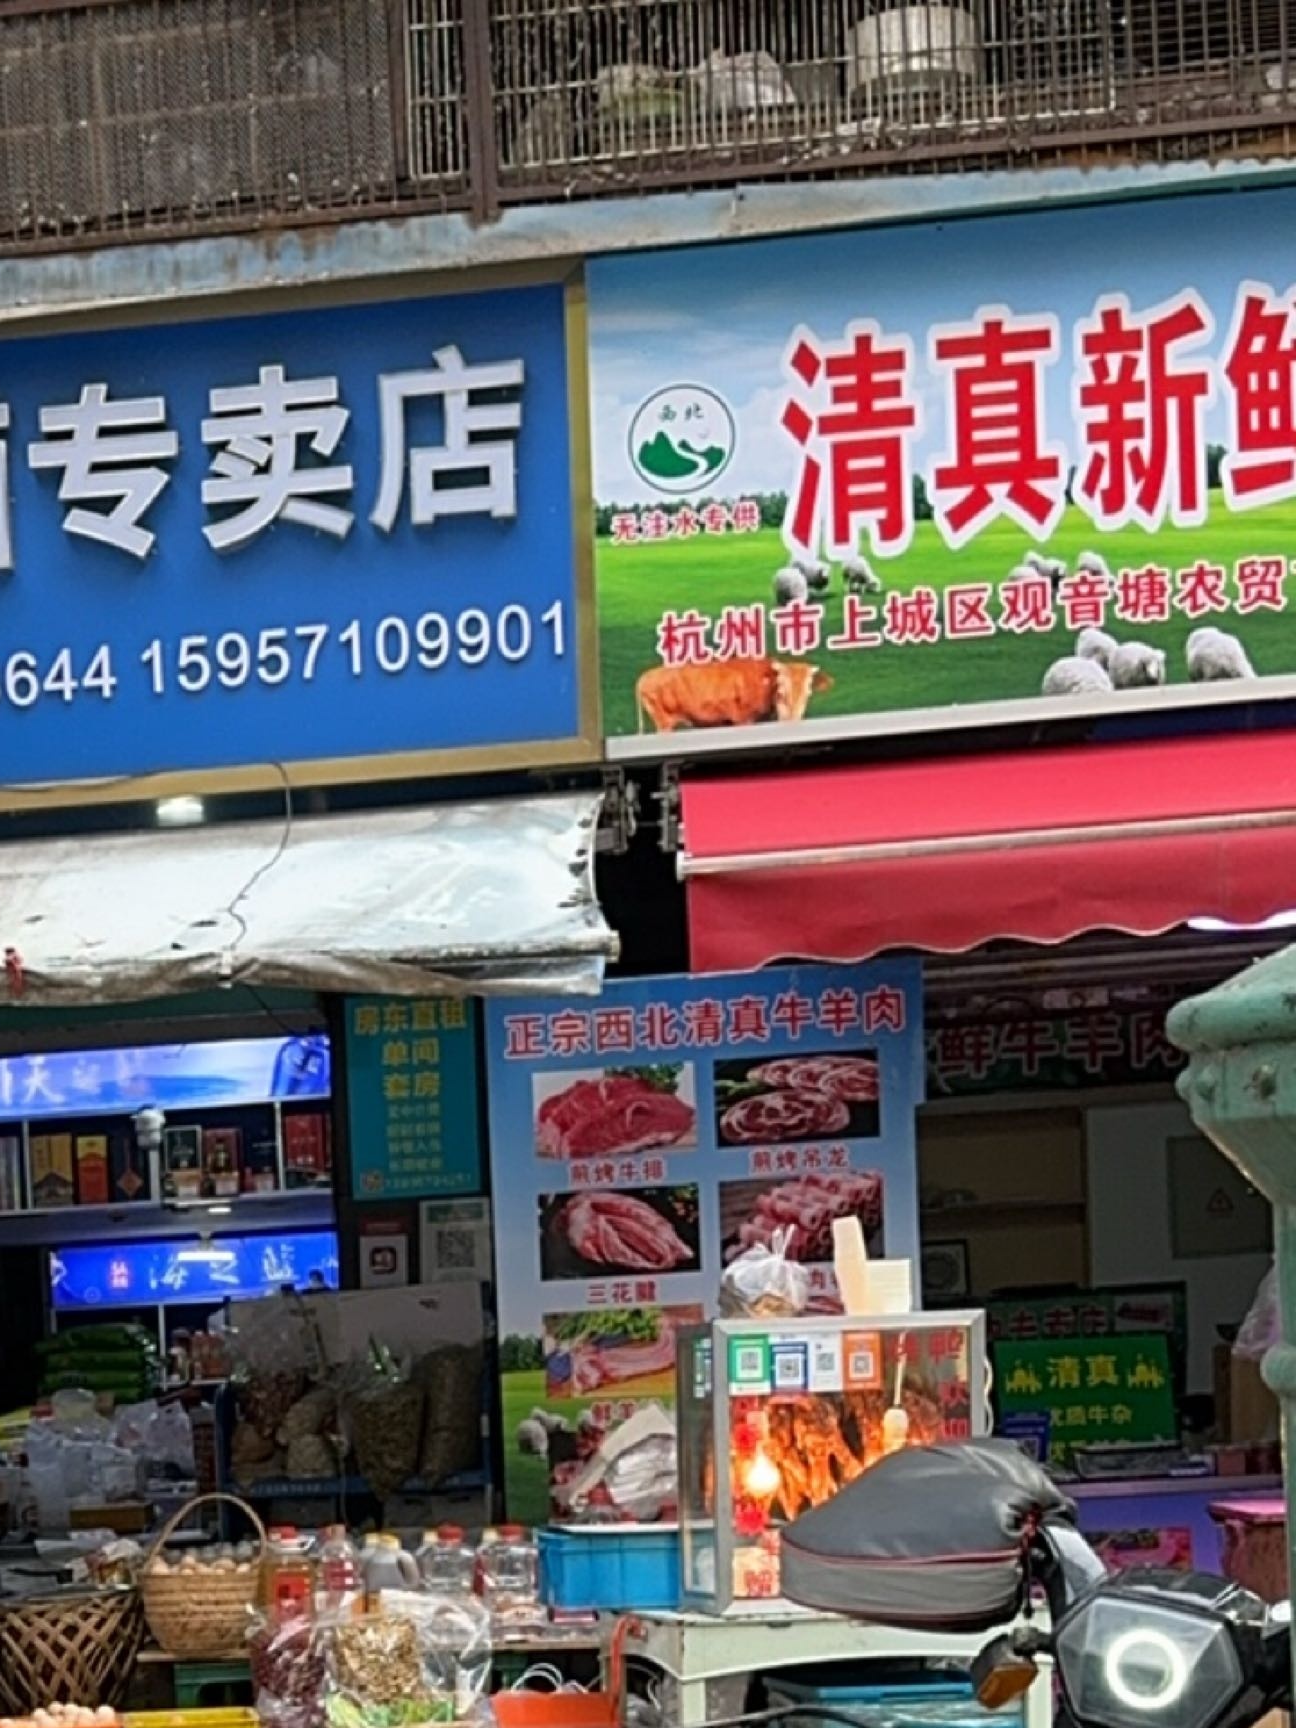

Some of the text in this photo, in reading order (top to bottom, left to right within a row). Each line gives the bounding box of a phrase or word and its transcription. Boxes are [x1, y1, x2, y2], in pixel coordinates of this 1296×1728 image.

[141, 601, 566, 695] 15957109901
[658, 559, 1282, 664] 杭州市上城区观音塘农贸
[506, 986, 904, 1058] 正宗西北清真牛羊肉
[1048, 1356, 1120, 1389] 清真
